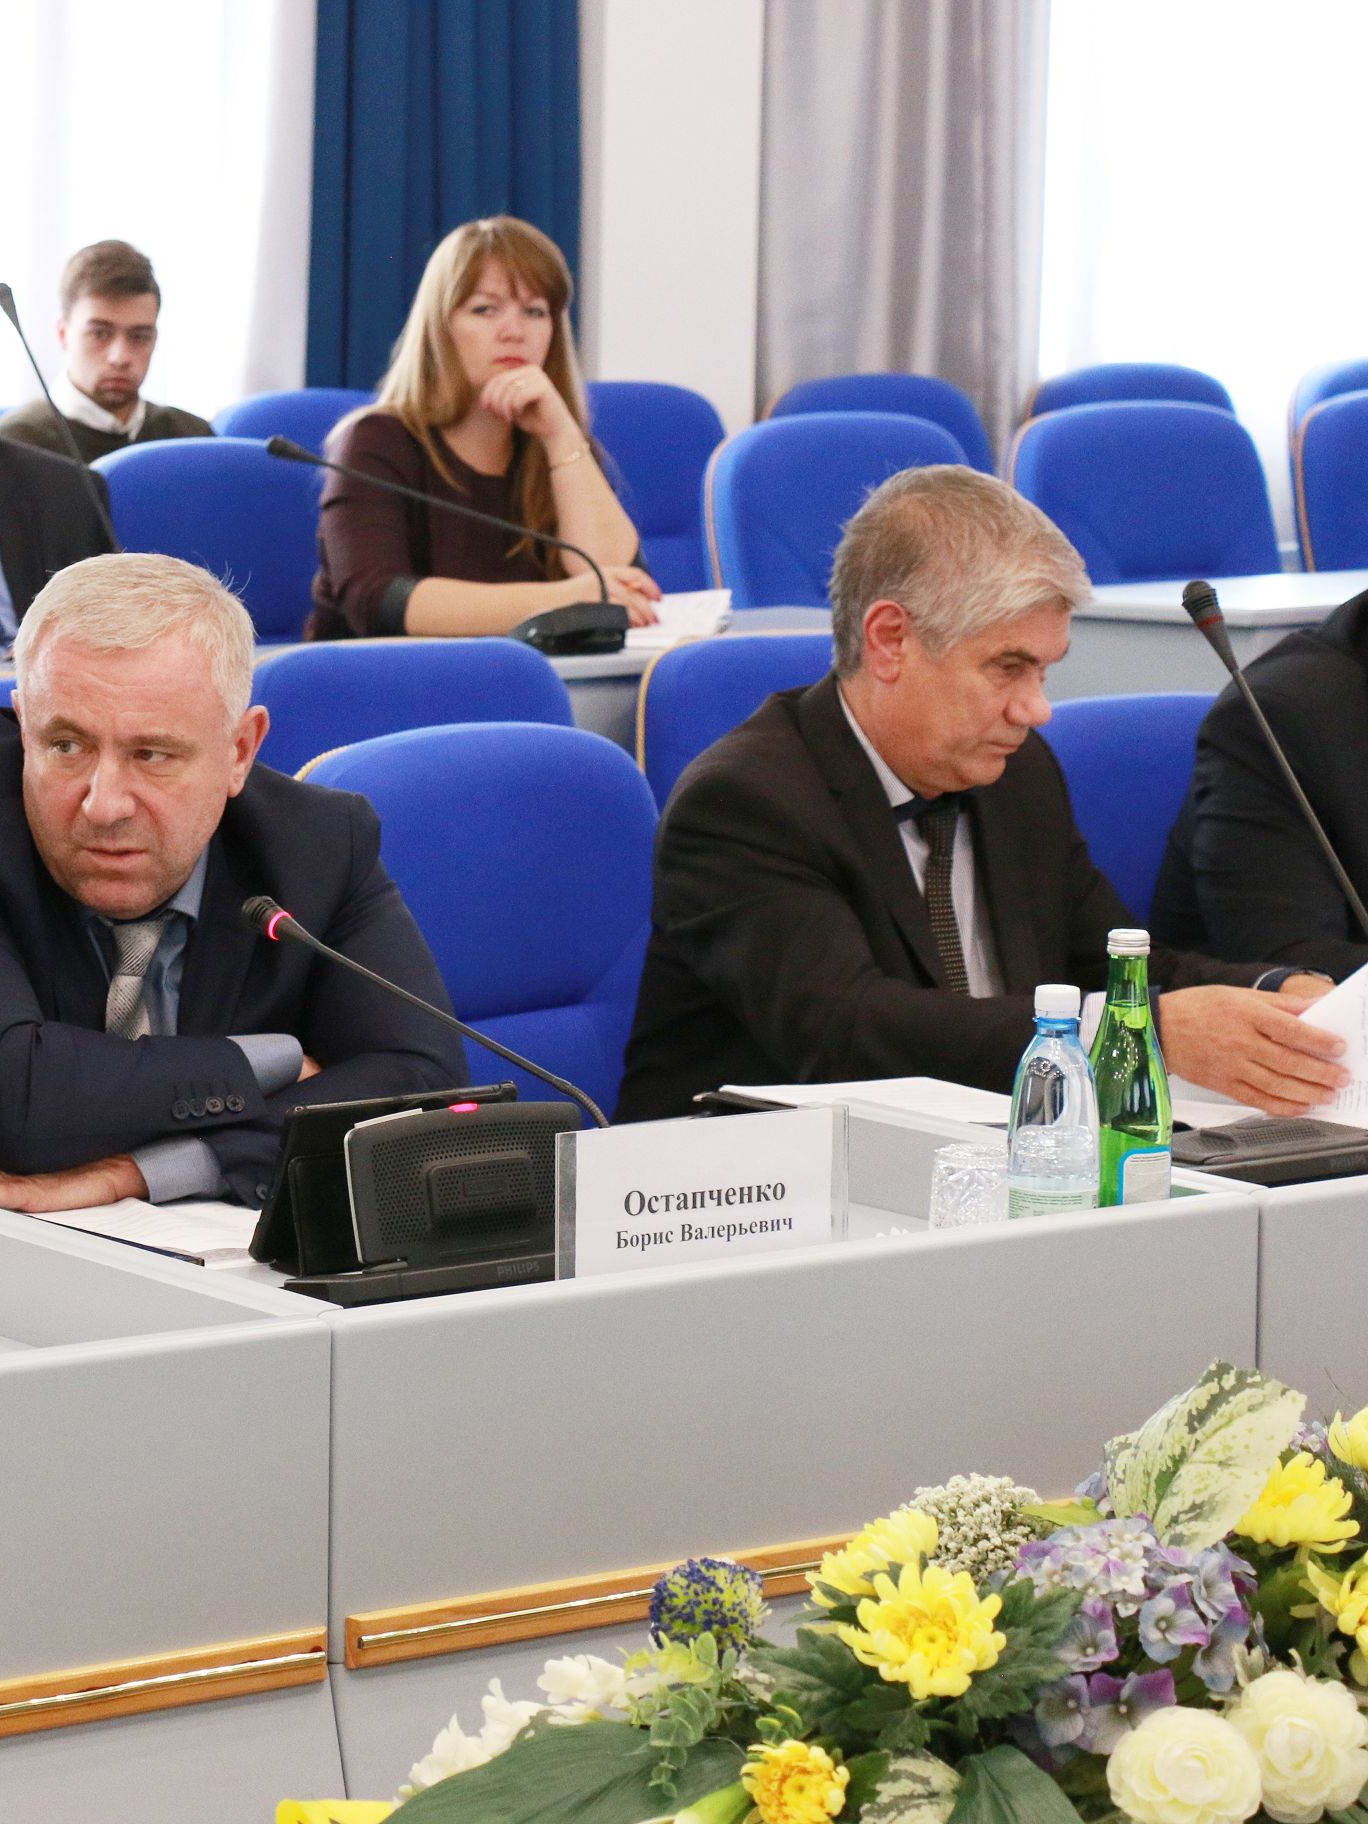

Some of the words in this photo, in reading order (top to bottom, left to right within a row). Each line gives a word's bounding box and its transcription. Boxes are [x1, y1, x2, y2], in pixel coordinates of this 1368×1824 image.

[623, 1182, 786, 1217] Остапченко
[615, 1230, 674, 1252] Борис
[680, 1217, 793, 1243] Валерьевич
